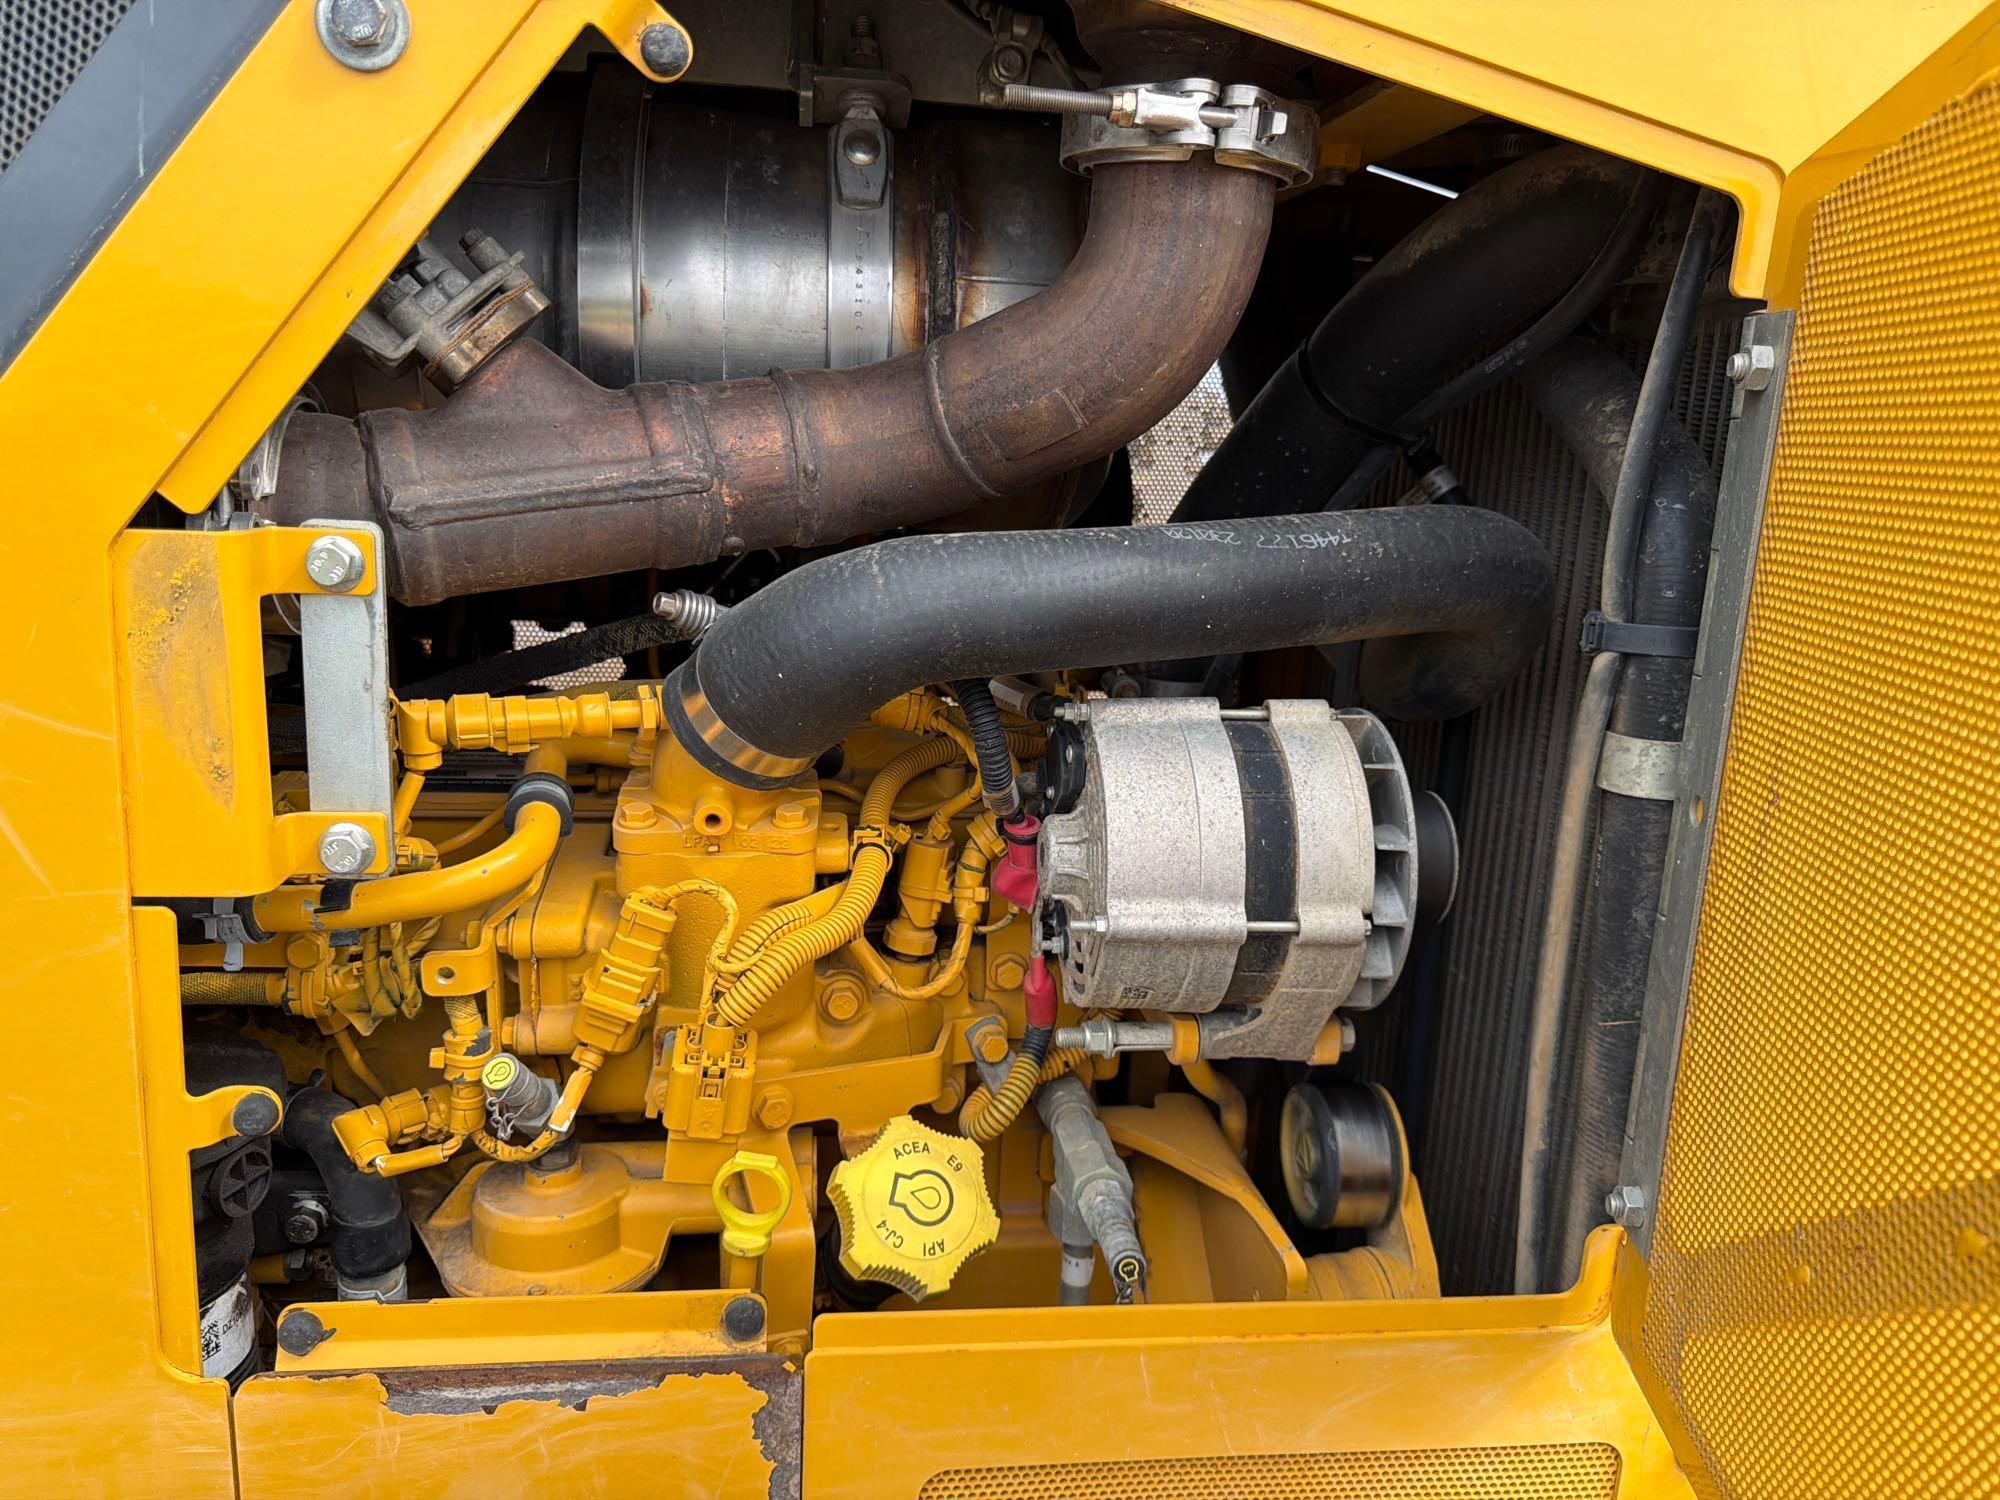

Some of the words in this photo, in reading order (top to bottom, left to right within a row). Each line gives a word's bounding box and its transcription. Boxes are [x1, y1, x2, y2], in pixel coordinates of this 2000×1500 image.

[893, 1141, 931, 1160] ACEA
[946, 1154, 963, 1173] E9
[876, 1219, 904, 1249] CJ-4
[922, 1238, 945, 1257] API
